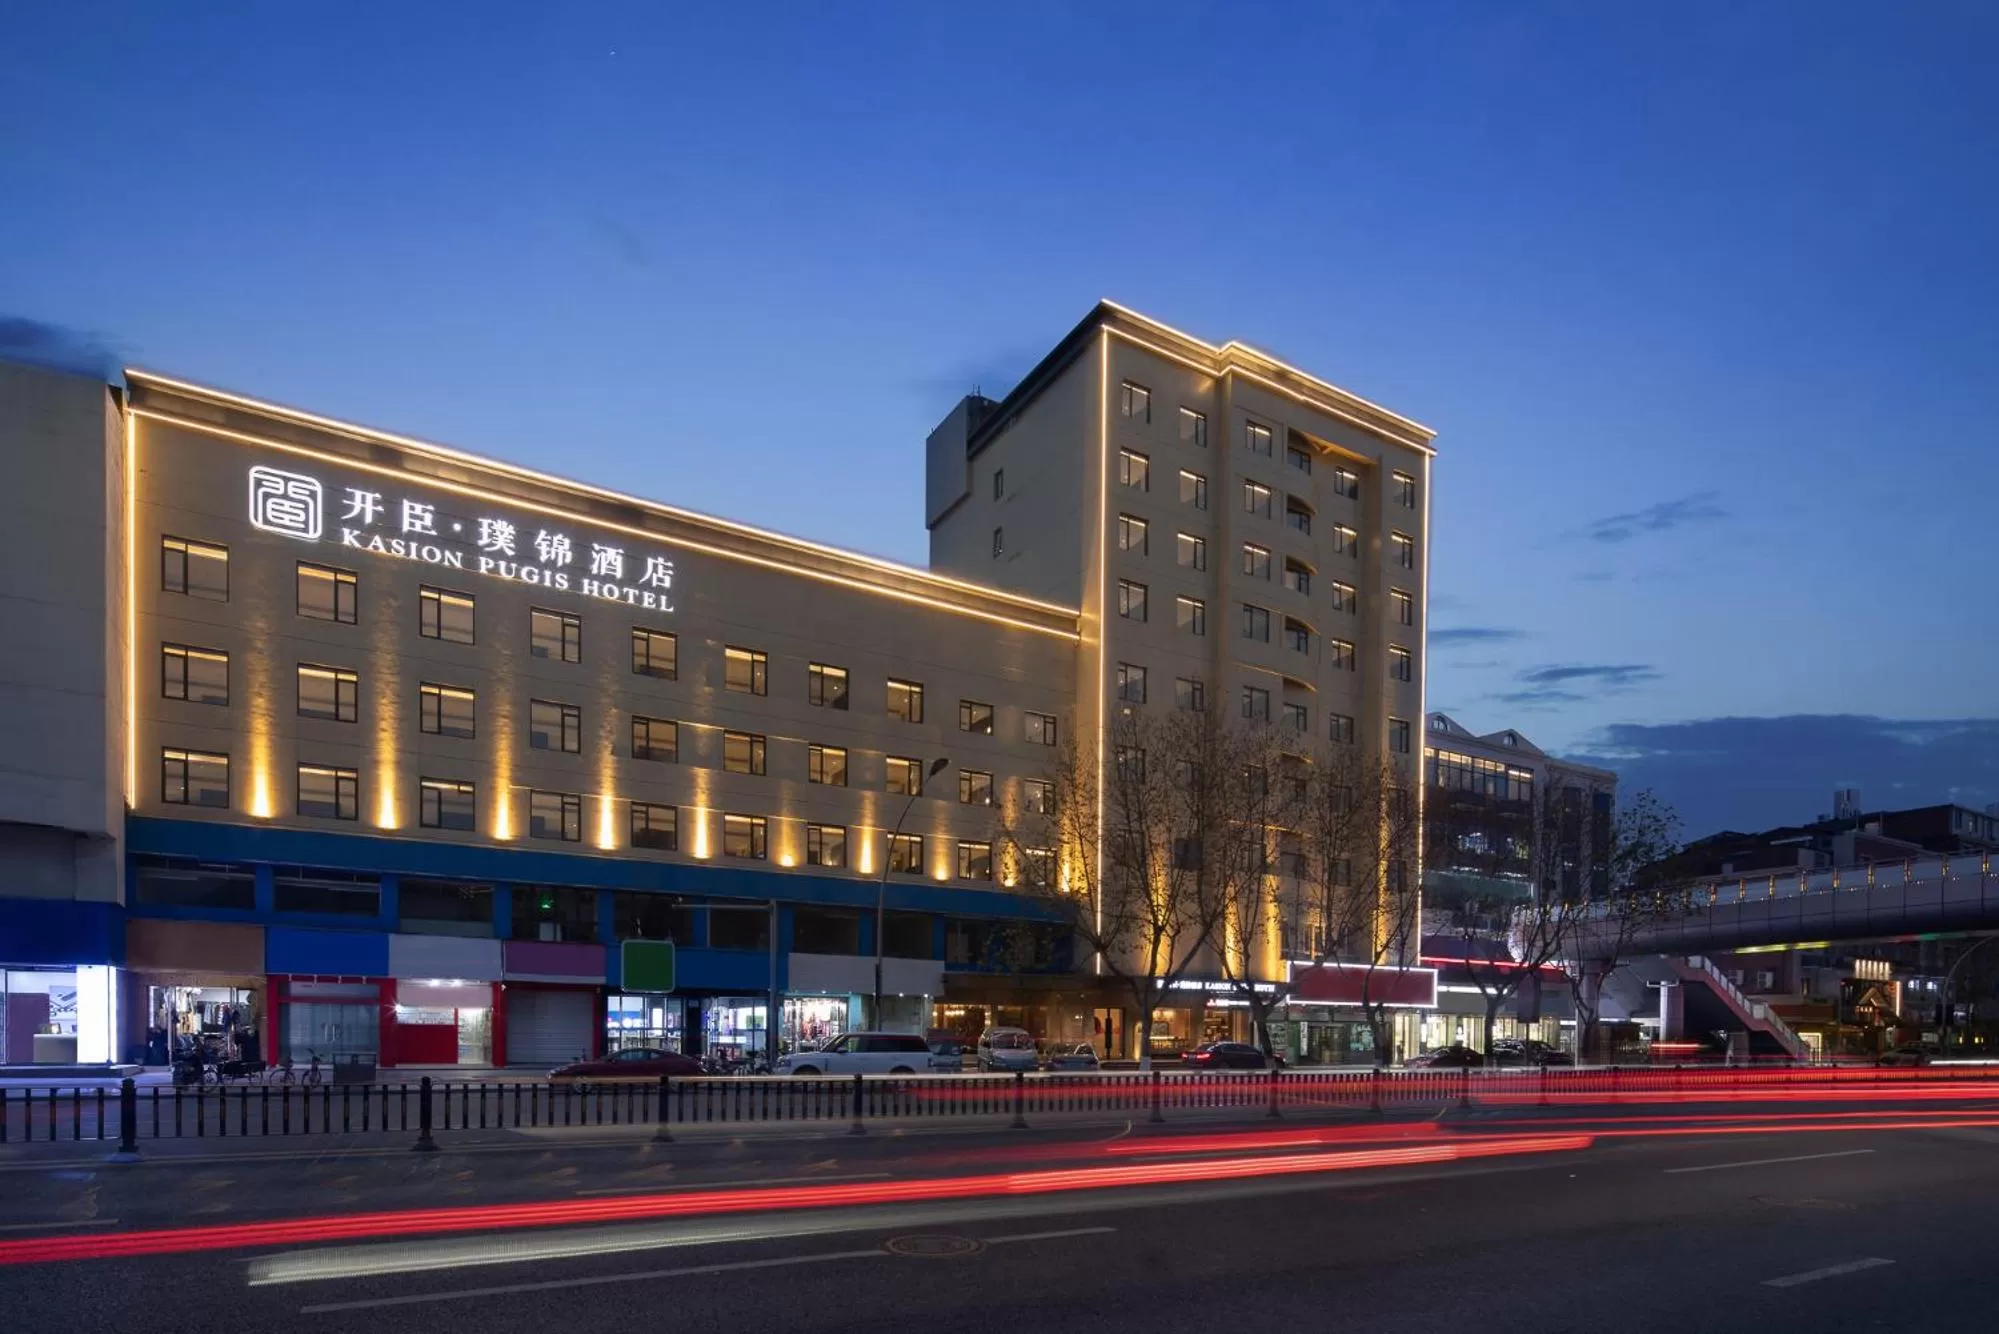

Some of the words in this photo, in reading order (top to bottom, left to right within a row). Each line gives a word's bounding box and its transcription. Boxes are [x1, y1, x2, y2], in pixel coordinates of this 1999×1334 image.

[341, 527, 464, 567] KASION
[479, 556, 569, 590] PUGIS
[582, 578, 675, 612] HOTEL
